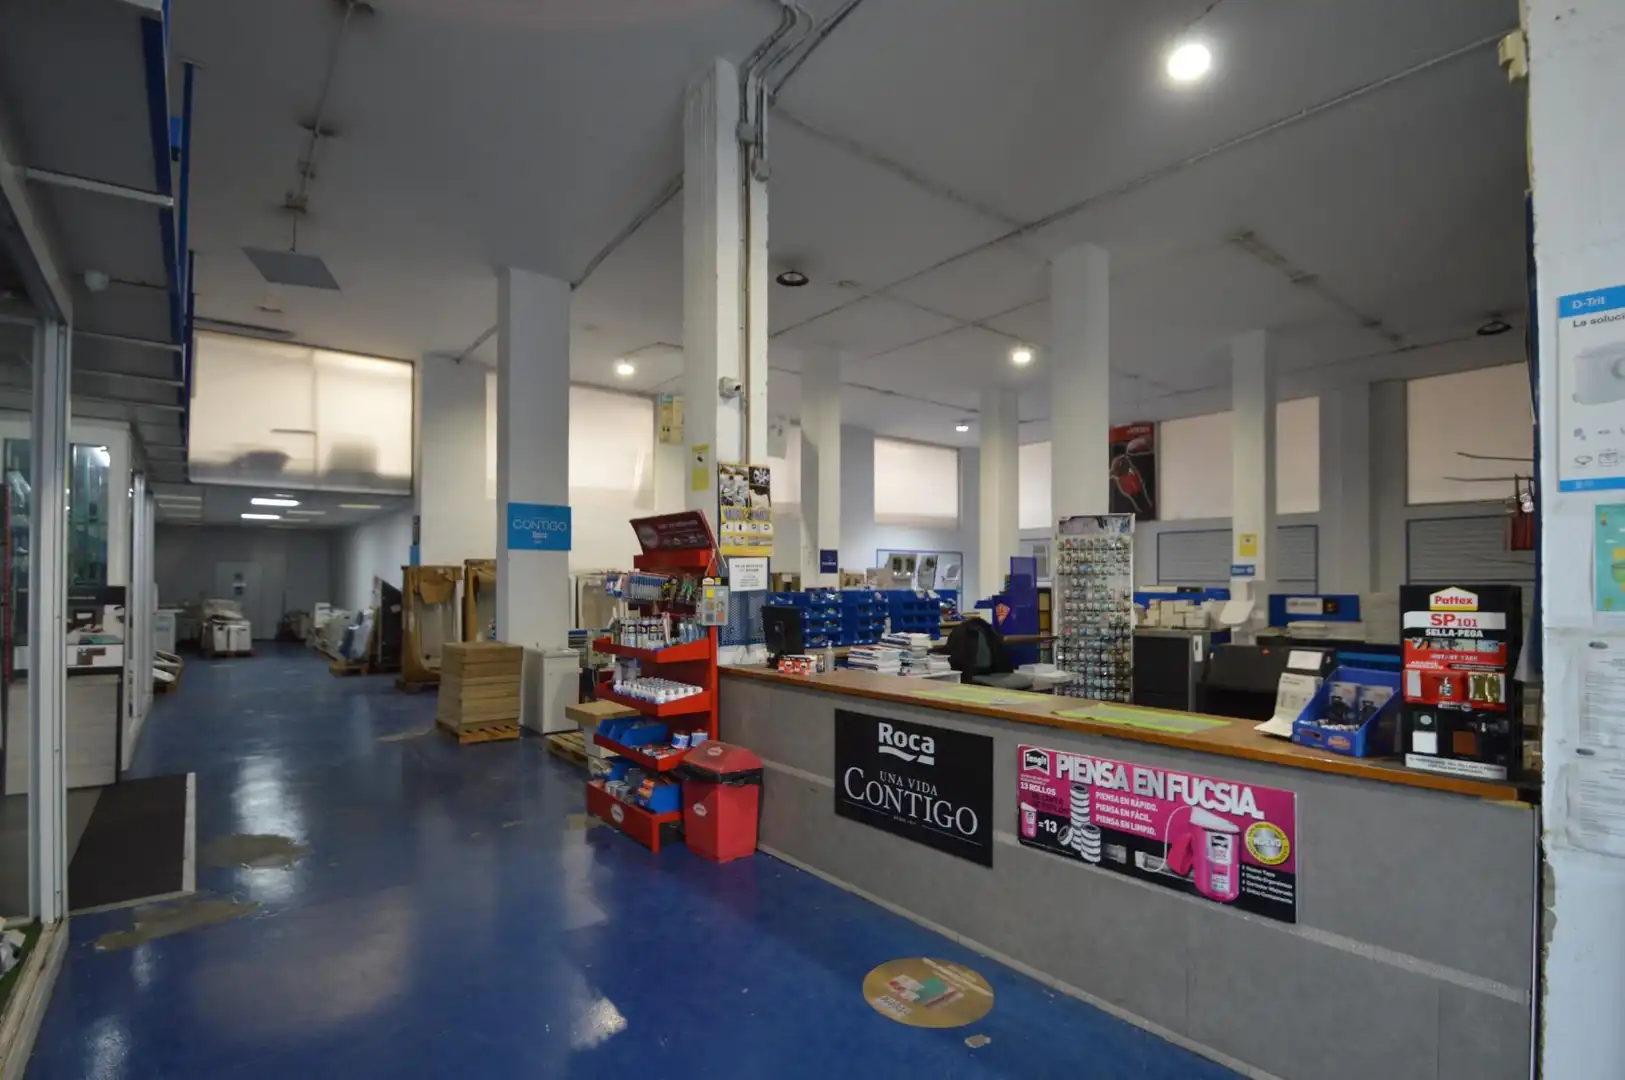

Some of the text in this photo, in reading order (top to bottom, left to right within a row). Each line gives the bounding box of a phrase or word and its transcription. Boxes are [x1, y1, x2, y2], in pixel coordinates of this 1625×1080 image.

[1573, 319, 1587, 328] La
[512, 518, 567, 532] CONTIGO
[1434, 596, 1473, 605] Pattex
[1425, 628, 1484, 638] SELLA-PEGA
[878, 722, 935, 755] Roca
[880, 770, 938, 796] UNA VIDA
[1056, 753, 1130, 792] PIENSA
[1133, 766, 1165, 800] EN
[1020, 781, 1056, 796] 13 ROLLOS
[844, 766, 978, 835] CONTIGO
[1095, 791, 1120, 803] PIENSA
[1120, 796, 1130, 805] EN
[1095, 802, 1120, 815] PIENSA
[1120, 808, 1130, 817] EN
[1095, 814, 1120, 826] PIENSA
[1120, 819, 1130, 829] EN
